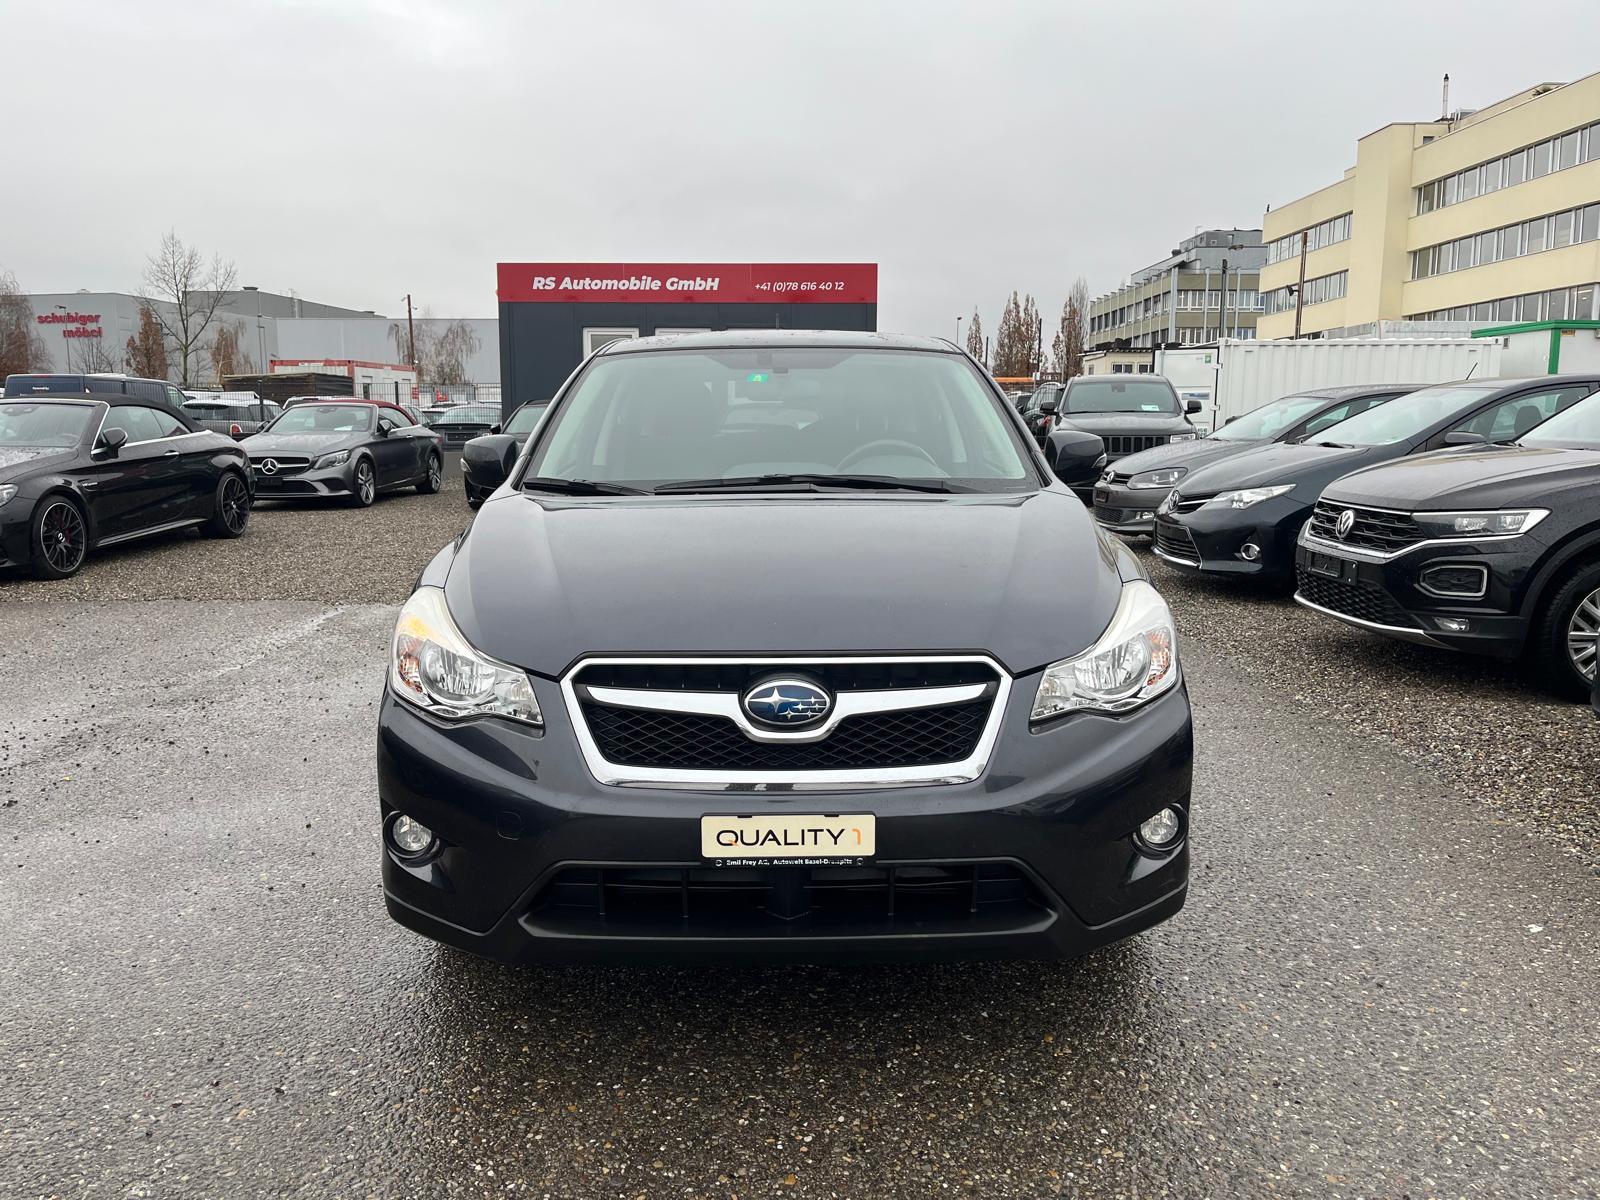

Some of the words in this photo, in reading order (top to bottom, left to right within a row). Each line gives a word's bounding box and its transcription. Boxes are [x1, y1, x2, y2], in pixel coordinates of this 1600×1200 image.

[532, 276, 556, 290] RS
[559, 275, 662, 291] Automobile
[665, 277, 720, 291] GmbH
[754, 281, 771, 291] +41
[773, 281, 799, 293] (0)78
[800, 281, 817, 291] 616
[818, 281, 832, 291] 40
[834, 281, 845, 291] 12
[36, 312, 102, 326] schubiger
[62, 326, 103, 338] möbel
[716, 828, 845, 847] QUALITY
[742, 859, 757, 867] Frey
